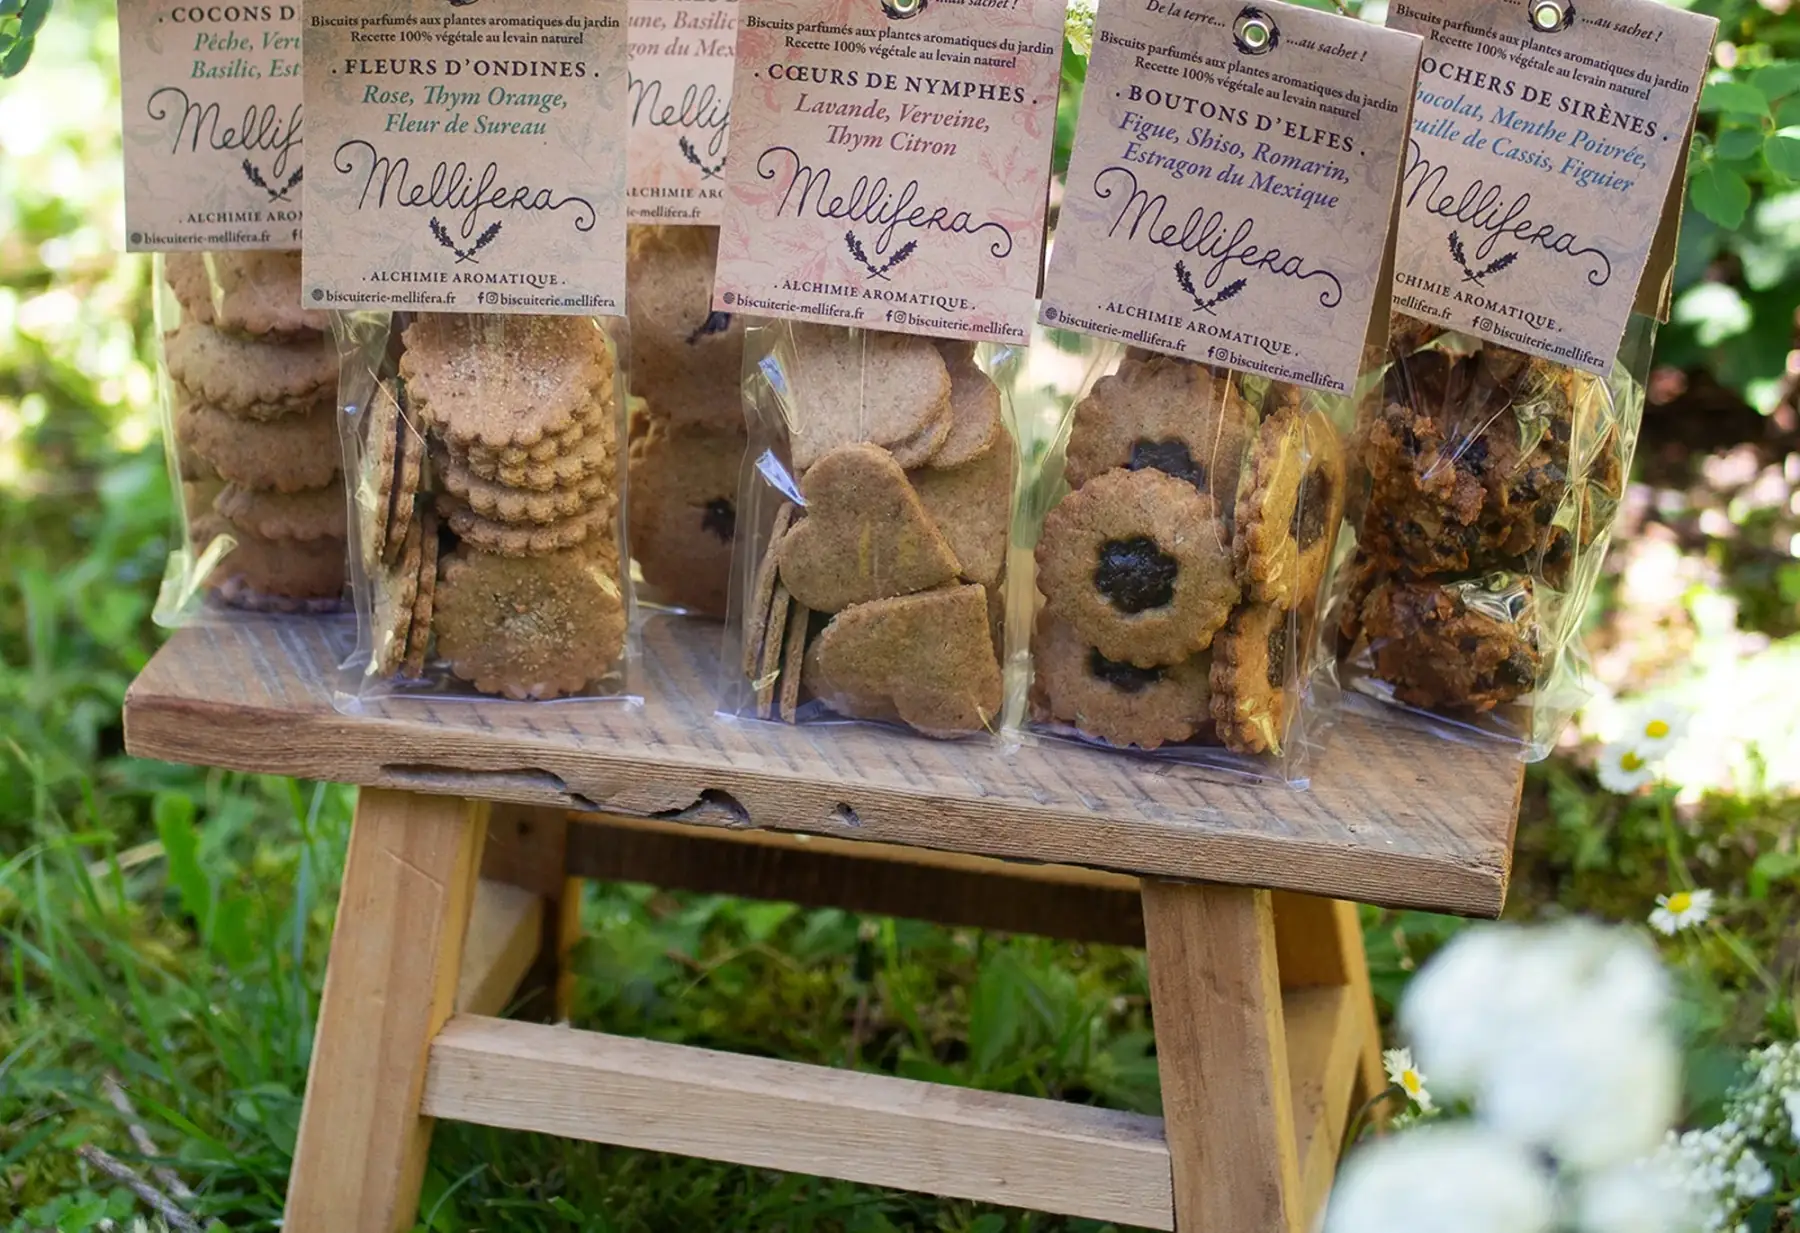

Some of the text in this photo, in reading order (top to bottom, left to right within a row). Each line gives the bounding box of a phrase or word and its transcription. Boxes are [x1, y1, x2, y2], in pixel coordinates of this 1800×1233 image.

[171, 5, 302, 22] COCONS D
[311, 14, 620, 30] Biscuits parfumés aux plantes aromatiques du jardin
[1146, 0, 1226, 28] De la terre...
[351, 31, 584, 46] Recette 100% végétale au levain naturel
[664, 36, 690, 56] du
[746, 15, 1054, 55] Biscuits parfumés aux plantes aromatiques du jardin
[1613, 23, 1654, 40] sachet
[785, 36, 1016, 69] Recette 100% végétale au levain naturel
[1318, 43, 1357, 60] sachet
[1396, 4, 1690, 94] Biscuits parfumés aux plantes aromatiques du jardin
[1430, 29, 1651, 101] Recette 100% végétale au levain naturel
[190, 58, 262, 80] Basilic,
[345, 59, 586, 77] FLEURS D’ONDINES
[768, 63, 1025, 104] CŒURS DE NYMPHES
[1100, 30, 1398, 114] Biscuits parfumés aux plantes aromatiques du jardin
[361, 85, 568, 113] Rose, Thym Orange,
[1135, 56, 1361, 121] Recette 100% végétale au levain naturel
[1421, 57, 1658, 138] OCHERS DE SIRÈNES
[384, 113, 547, 135] Fleur de Sureau
[794, 93, 990, 132] Lavande, Verveine,
[1127, 84, 1353, 153] BOUTONS D’ELFES
[826, 124, 957, 157] Thym Citron
[1118, 111, 1351, 185] Figue, Shiso, Romarin,
[1489, 107, 1567, 143] Menthe
[1568, 128, 1649, 170] Poivrée,
[1412, 118, 1635, 193] uille de Cassis, Figuier
[1120, 142, 1339, 209] Estragon du Mexique
[627, 187, 694, 198] LCHIMIE
[187, 212, 262, 223] ALCHIMIE
[144, 231, 271, 245] biscuiterie-mellifera.fr
[370, 271, 558, 289] ALCHIMIE AROMATIQUE
[782, 280, 969, 312] ALCHIMIE AROMATIQUE
[326, 290, 616, 308] biscuiterie-mellifera.fr biscuiterie.mellifera
[737, 293, 1024, 337] biscuiterie-mellifera.fr biscuiterie.mellifera
[1395, 272, 1556, 331] CHIMIE AROMATIQUE
[1106, 302, 1292, 356] ALCHIMIE AROMATIQUE
[1058, 310, 1345, 391] biscuiterie-mellifera.fr biscuiterie.mellifera
[1493, 323, 1605, 369] biscuiterie.mellifera
